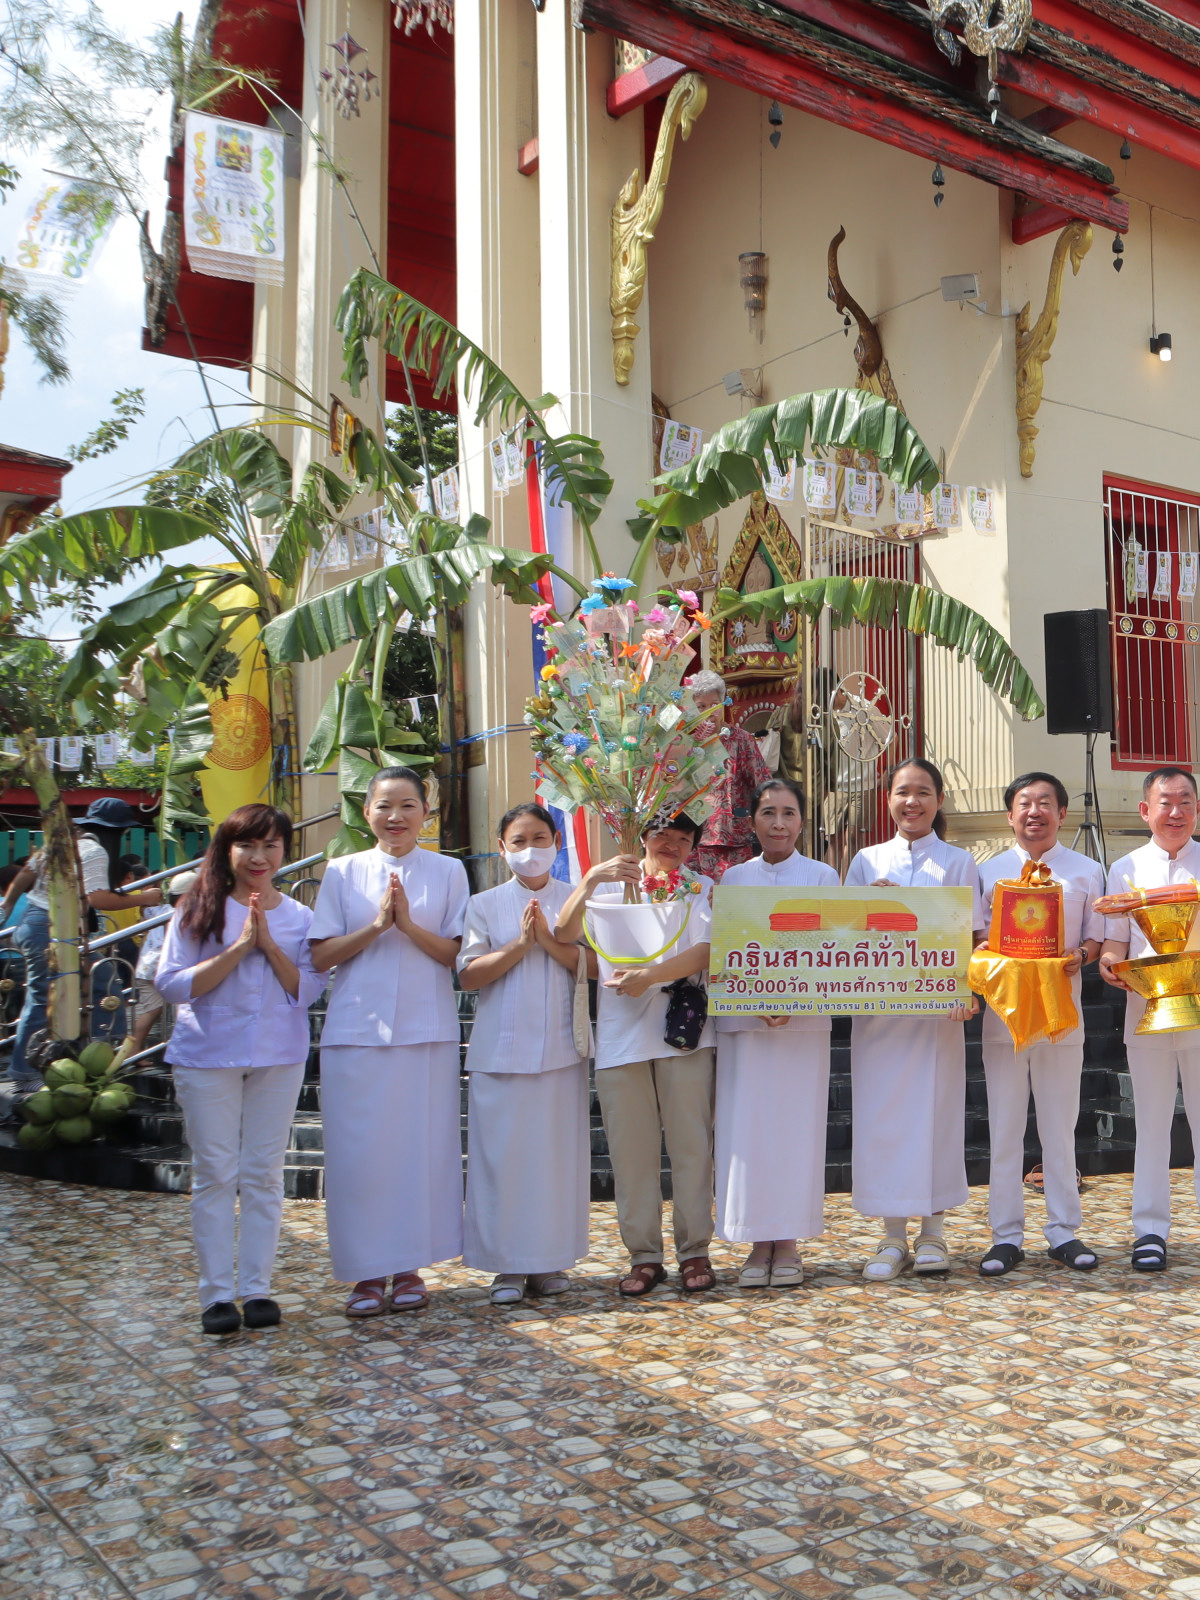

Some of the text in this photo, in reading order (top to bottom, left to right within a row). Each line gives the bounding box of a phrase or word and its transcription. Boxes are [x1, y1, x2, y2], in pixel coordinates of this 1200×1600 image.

[728, 935, 955, 976] กฐินสามัคคีทั่วไทย
[726, 976, 956, 999] 30,000วัด พุทธศักราช 2568
[714, 1001, 732, 1011] โดย
[736, 1000, 813, 1013] คณะศิษยานุศิษย์
[817, 1003, 860, 1013] บูชาธรรม
[864, 1002, 876, 1010] 81
[879, 1000, 886, 1010] ปี
